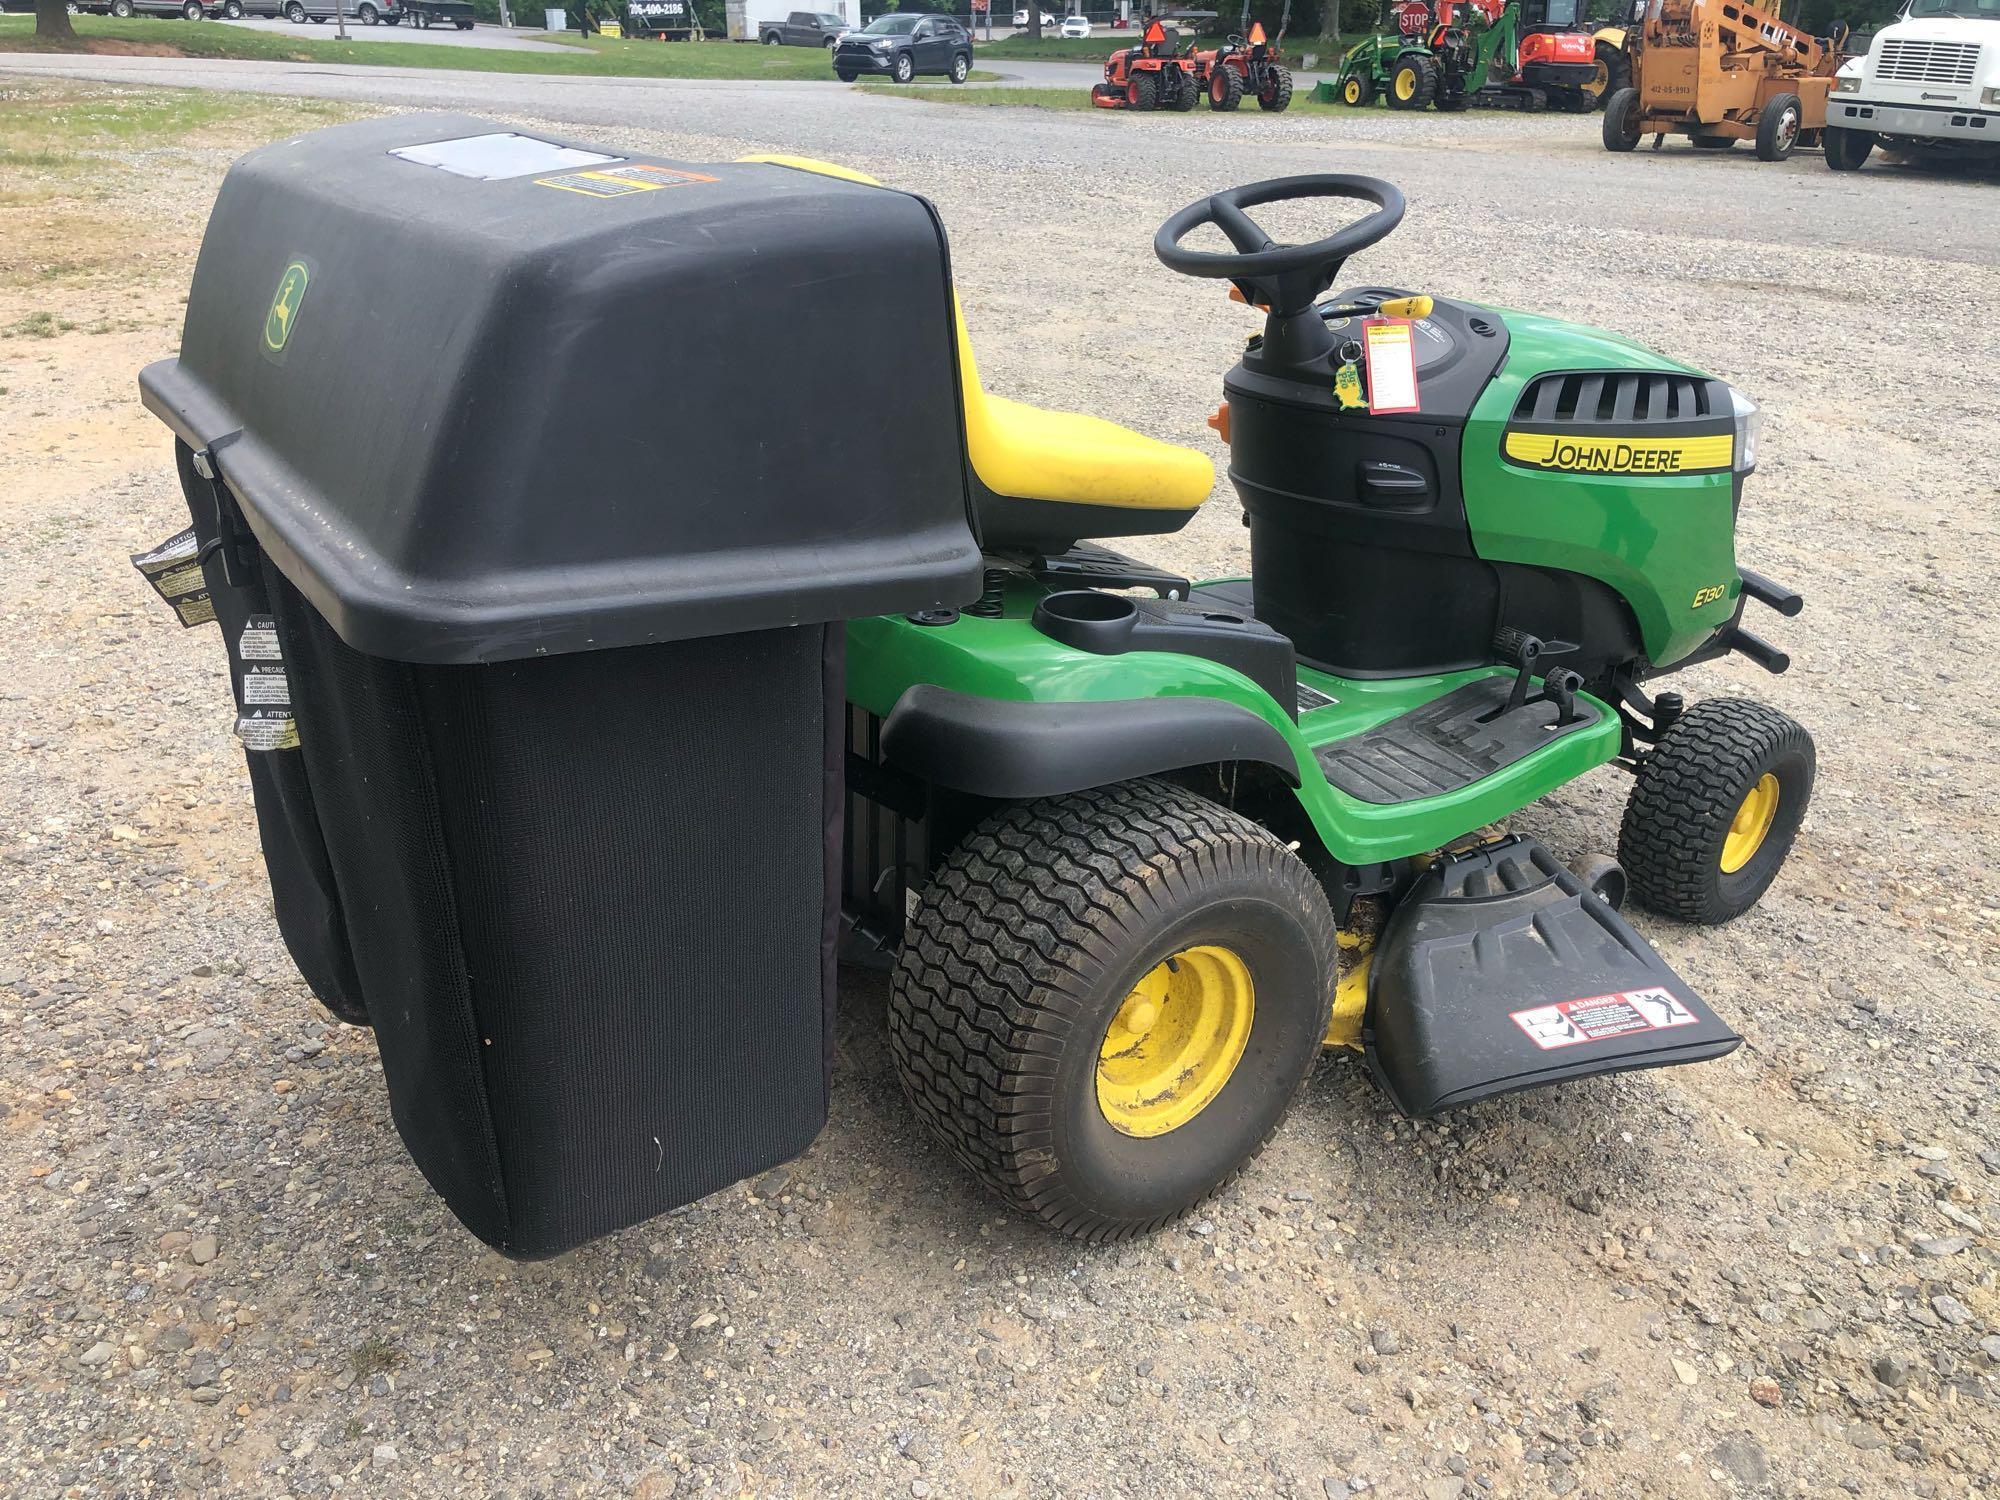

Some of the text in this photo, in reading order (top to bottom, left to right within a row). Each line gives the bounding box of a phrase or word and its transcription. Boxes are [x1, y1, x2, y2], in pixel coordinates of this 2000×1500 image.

[1402, 13, 1428, 26] STOP
[1541, 439, 1683, 469] JOHN DEERE
[1691, 584, 1725, 609] E130
[1576, 996, 1618, 1009] DANGER
